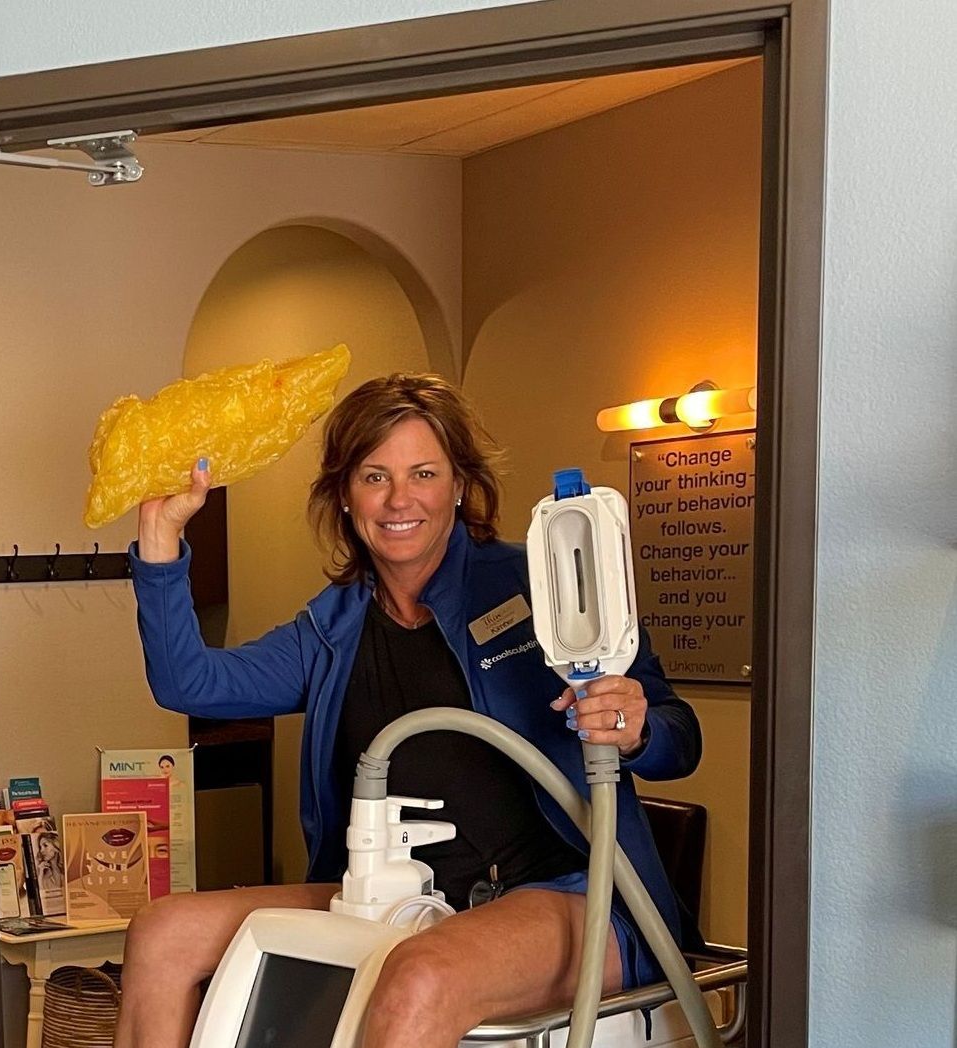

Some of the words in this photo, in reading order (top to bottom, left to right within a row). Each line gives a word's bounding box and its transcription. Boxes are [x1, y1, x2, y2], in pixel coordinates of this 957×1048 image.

[635, 478, 672, 496] your
[637, 501, 673, 519] your
[677, 494, 754, 512] behavior
[660, 519, 727, 536] follows.
[640, 544, 703, 561] Change
[709, 542, 749, 560] your
[650, 566, 736, 583] behavior...
[659, 589, 690, 604] and
[695, 590, 727, 608] you
[642, 612, 702, 631] change
[706, 613, 745, 632] your
[492, 640, 539, 663] coolsculptin
[669, 660, 725, 673] Unknown
[109, 761, 145, 772] MINT
[86, 851, 128, 860] LOVE
[86, 863, 128, 873] YOUR
[87, 875, 129, 885] LIPS
